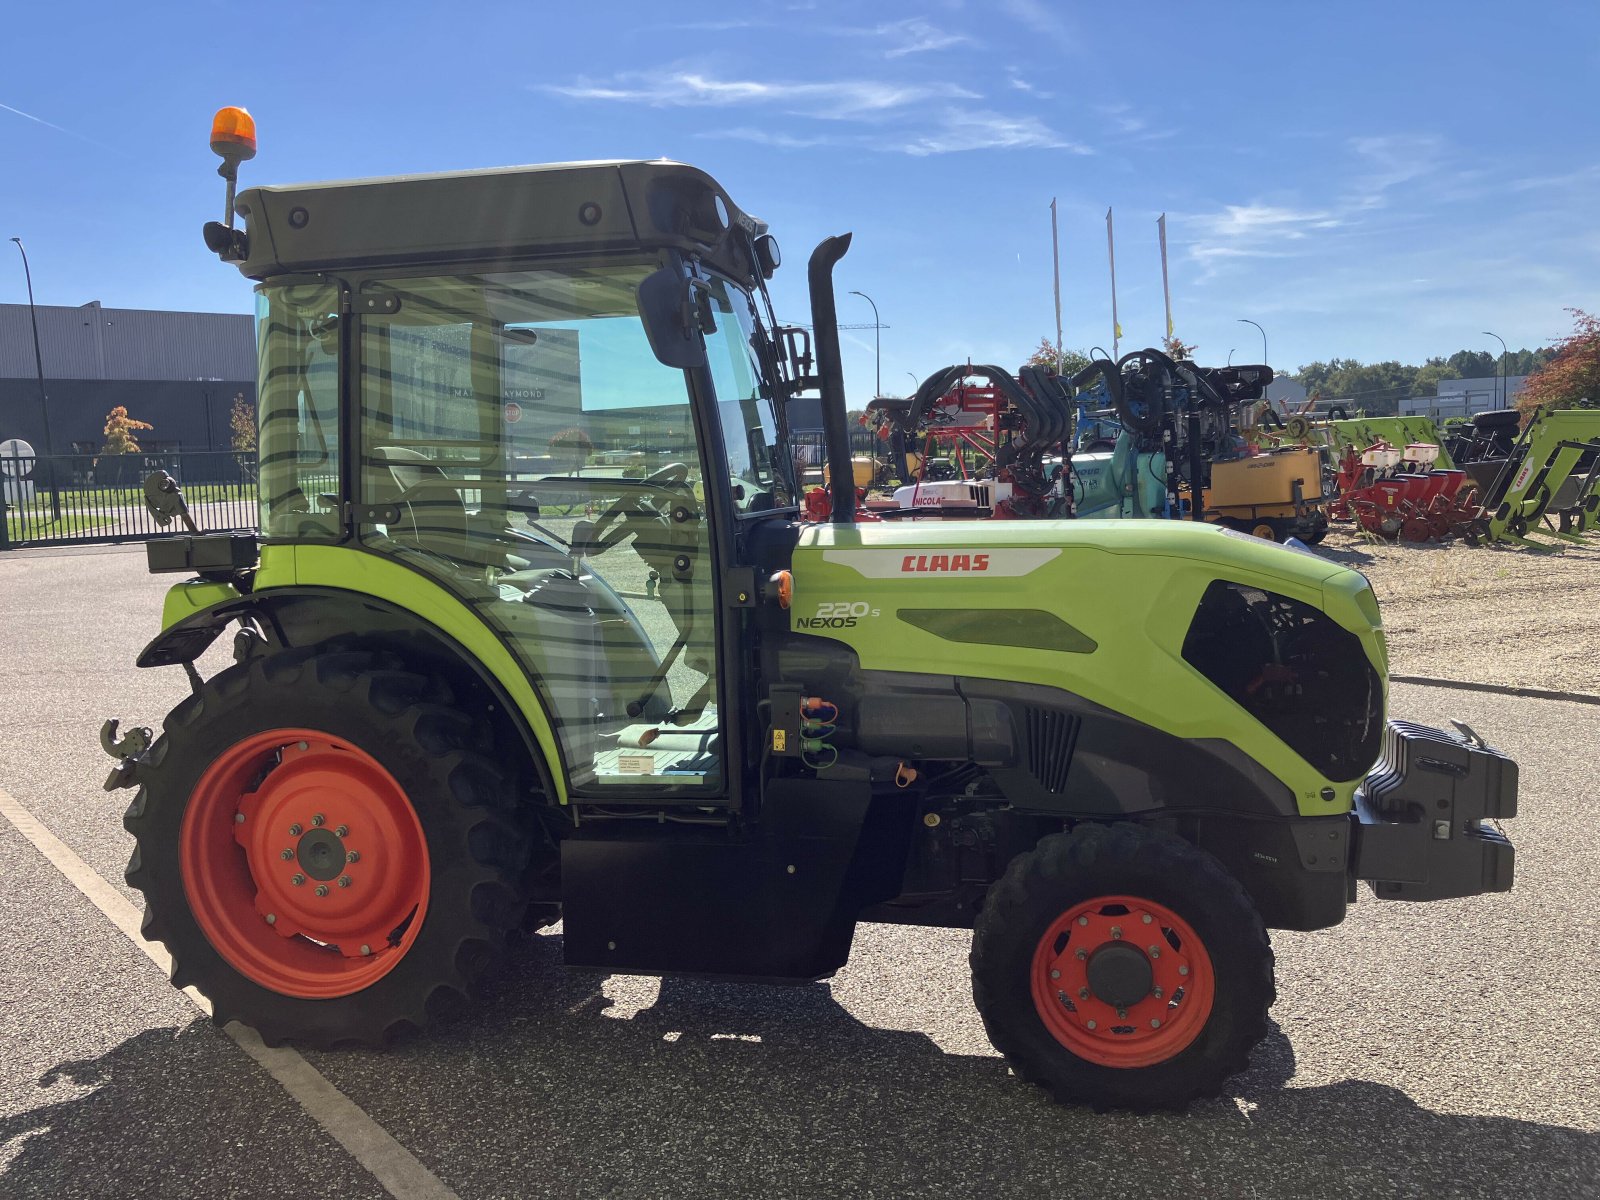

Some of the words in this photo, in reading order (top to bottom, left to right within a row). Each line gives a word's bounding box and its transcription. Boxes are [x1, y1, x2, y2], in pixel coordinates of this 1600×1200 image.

[1516, 467, 1528, 487] CLAAS
[914, 496, 946, 506] NICOLA
[901, 554, 989, 572] CLAAS
[816, 601, 870, 618] 220
[796, 617, 858, 628] NEXOS
